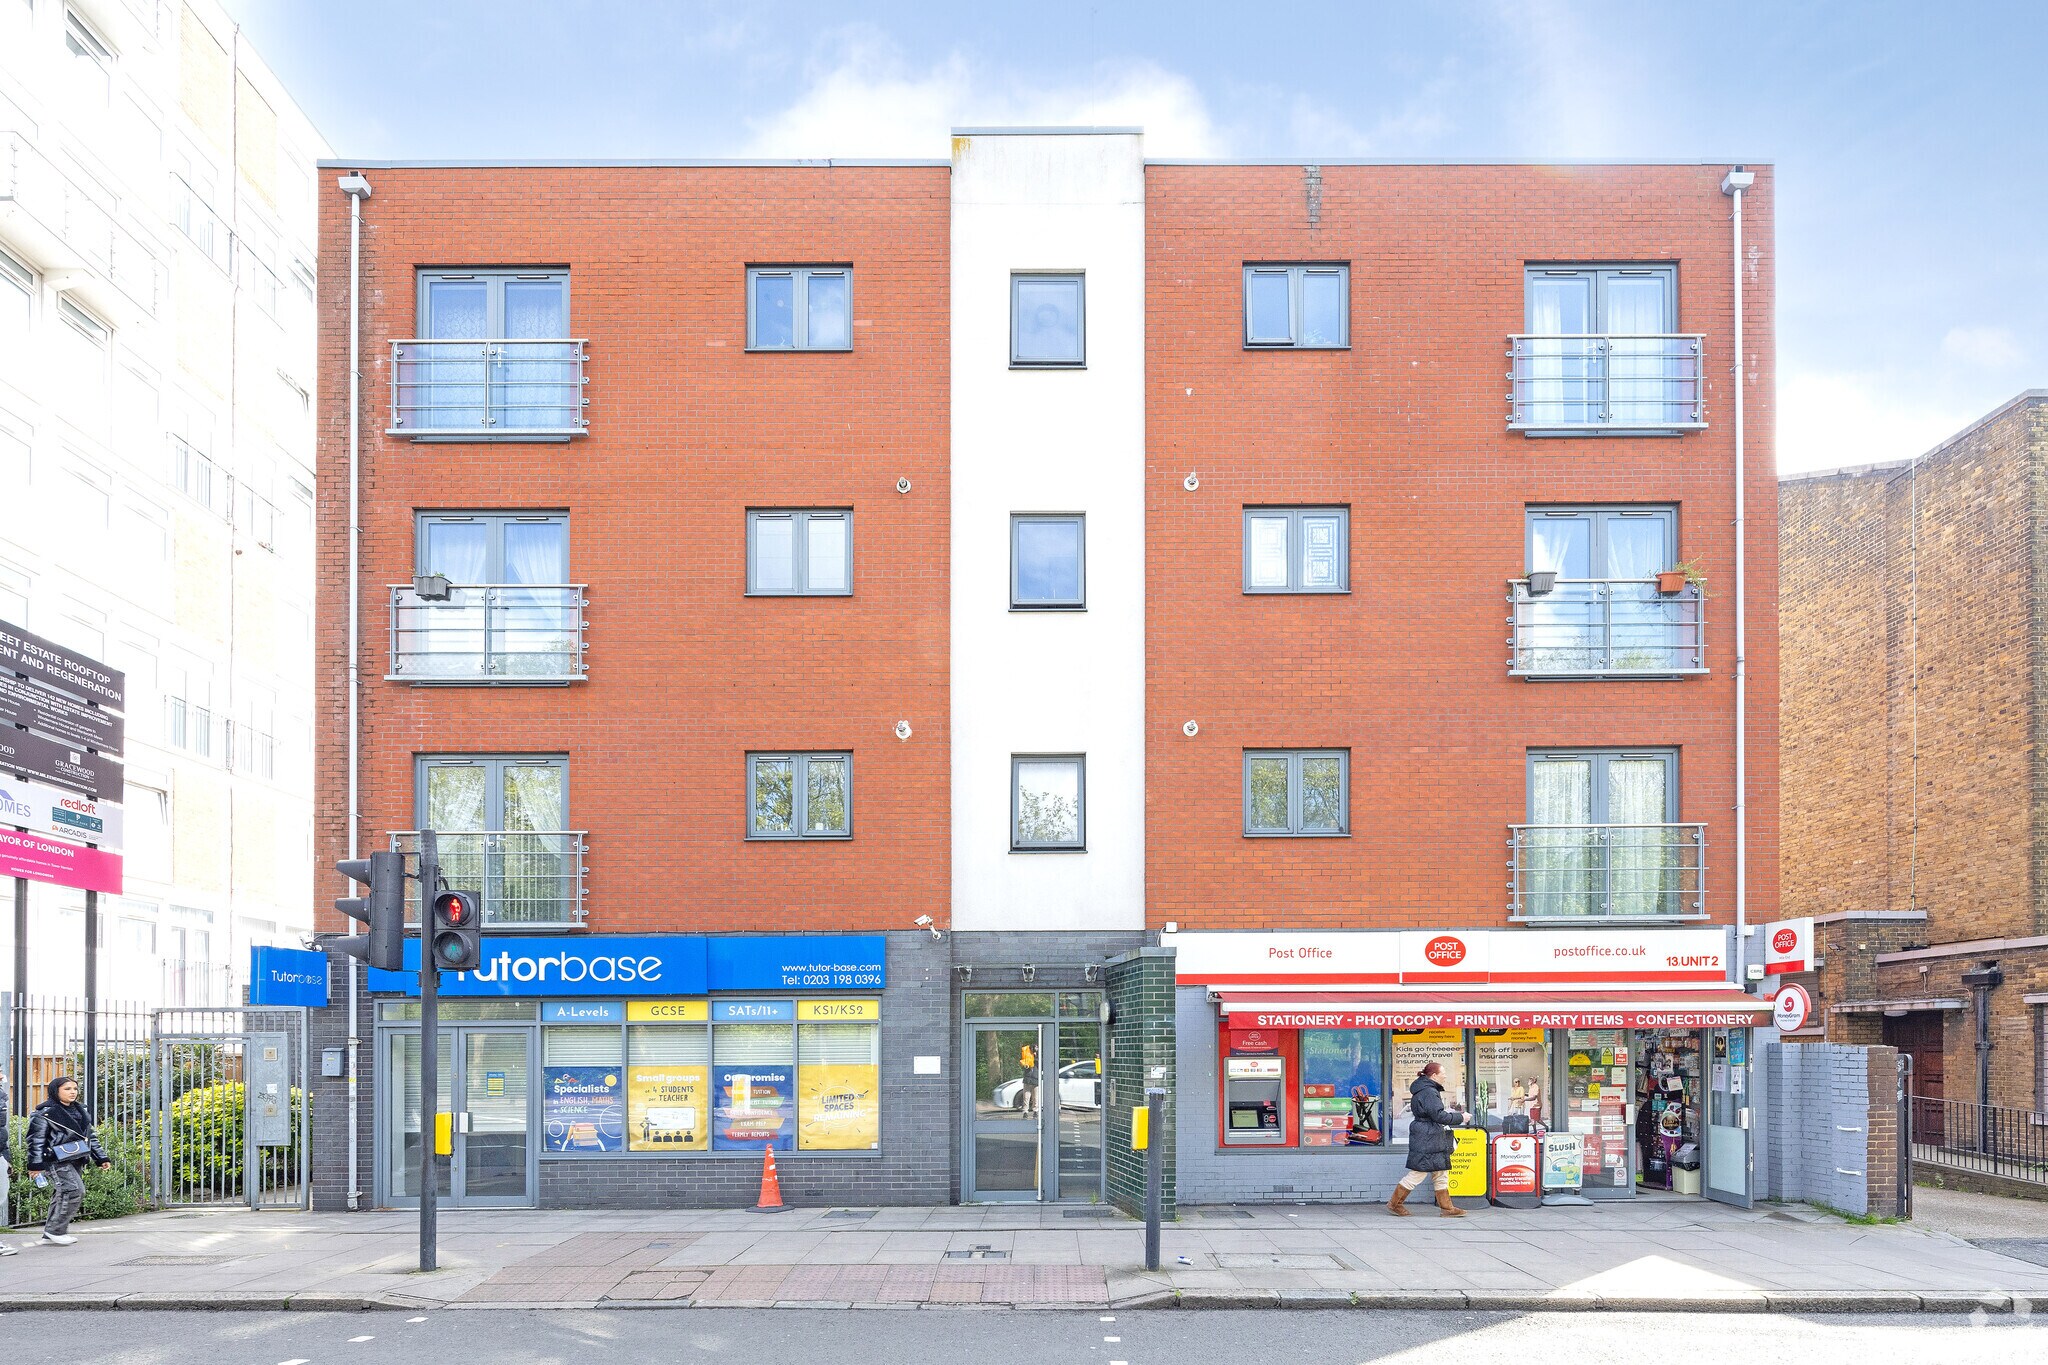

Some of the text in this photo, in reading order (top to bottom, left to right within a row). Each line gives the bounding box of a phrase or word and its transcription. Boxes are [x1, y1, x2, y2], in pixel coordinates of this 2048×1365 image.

[24, 641, 62, 665] ESTATE
[64, 658, 111, 684] ROOFTOP
[21, 654, 44, 670] AND
[47, 663, 122, 702] REGENERATION
[7, 690, 69, 717] ENVIRONMENTAL WORKS
[14, 687, 50, 704] CONJUNCTION
[50, 700, 63, 709] WITH
[63, 705, 81, 716] ESTATE
[80, 711, 113, 727] IMPROVEMENT
[25, 685, 47, 697] DELIVER
[55, 697, 67, 705] NEW
[67, 701, 84, 712] HOMES
[84, 707, 109, 721] INCLUDING
[55, 759, 95, 777] GRACEWOOD
[60, 798, 96, 815] redloft
[59, 826, 88, 839] ARCADIS
[22, 839, 36, 849] OF
[37, 842, 75, 858] LONDON
[1777, 932, 1793, 941] POST
[1433, 942, 1459, 951] POST
[1774, 939, 1795, 949] OFFICE
[1269, 947, 1333, 959] Post Office
[1428, 950, 1462, 960] OFFICE
[1553, 945, 1647, 958] postoffice.co.uk
[781, 963, 882, 973] www.tutor-base.com
[782, 974, 882, 986] Tel: 0203 198 0396
[557, 1006, 609, 1018] A-Levels
[650, 1005, 686, 1017] GCSE
[728, 1005, 779, 1017] SATs/11+
[813, 1004, 864, 1016] KS1/KS2
[1257, 1013, 1755, 1026] STATIONERY PHOTOCOPY PRINTING PARTY ITEMS CONFECTIONERY
[635, 1074, 700, 1084] Small groups
[553, 1083, 610, 1096] Specialists
[652, 1086, 658, 1094] 4
[660, 1085, 695, 1094] STUDENTS
[559, 1096, 590, 1106] ENGLISH,
[591, 1096, 614, 1104] MATHS
[658, 1094, 689, 1102] TEACHER
[821, 1093, 855, 1105] LIMITED
[559, 1106, 589, 1114] SCIENCE
[824, 1102, 855, 1112] SPACES
[813, 1110, 866, 1122] REMAINING
[1548, 1142, 1576, 1152] SLUSH
